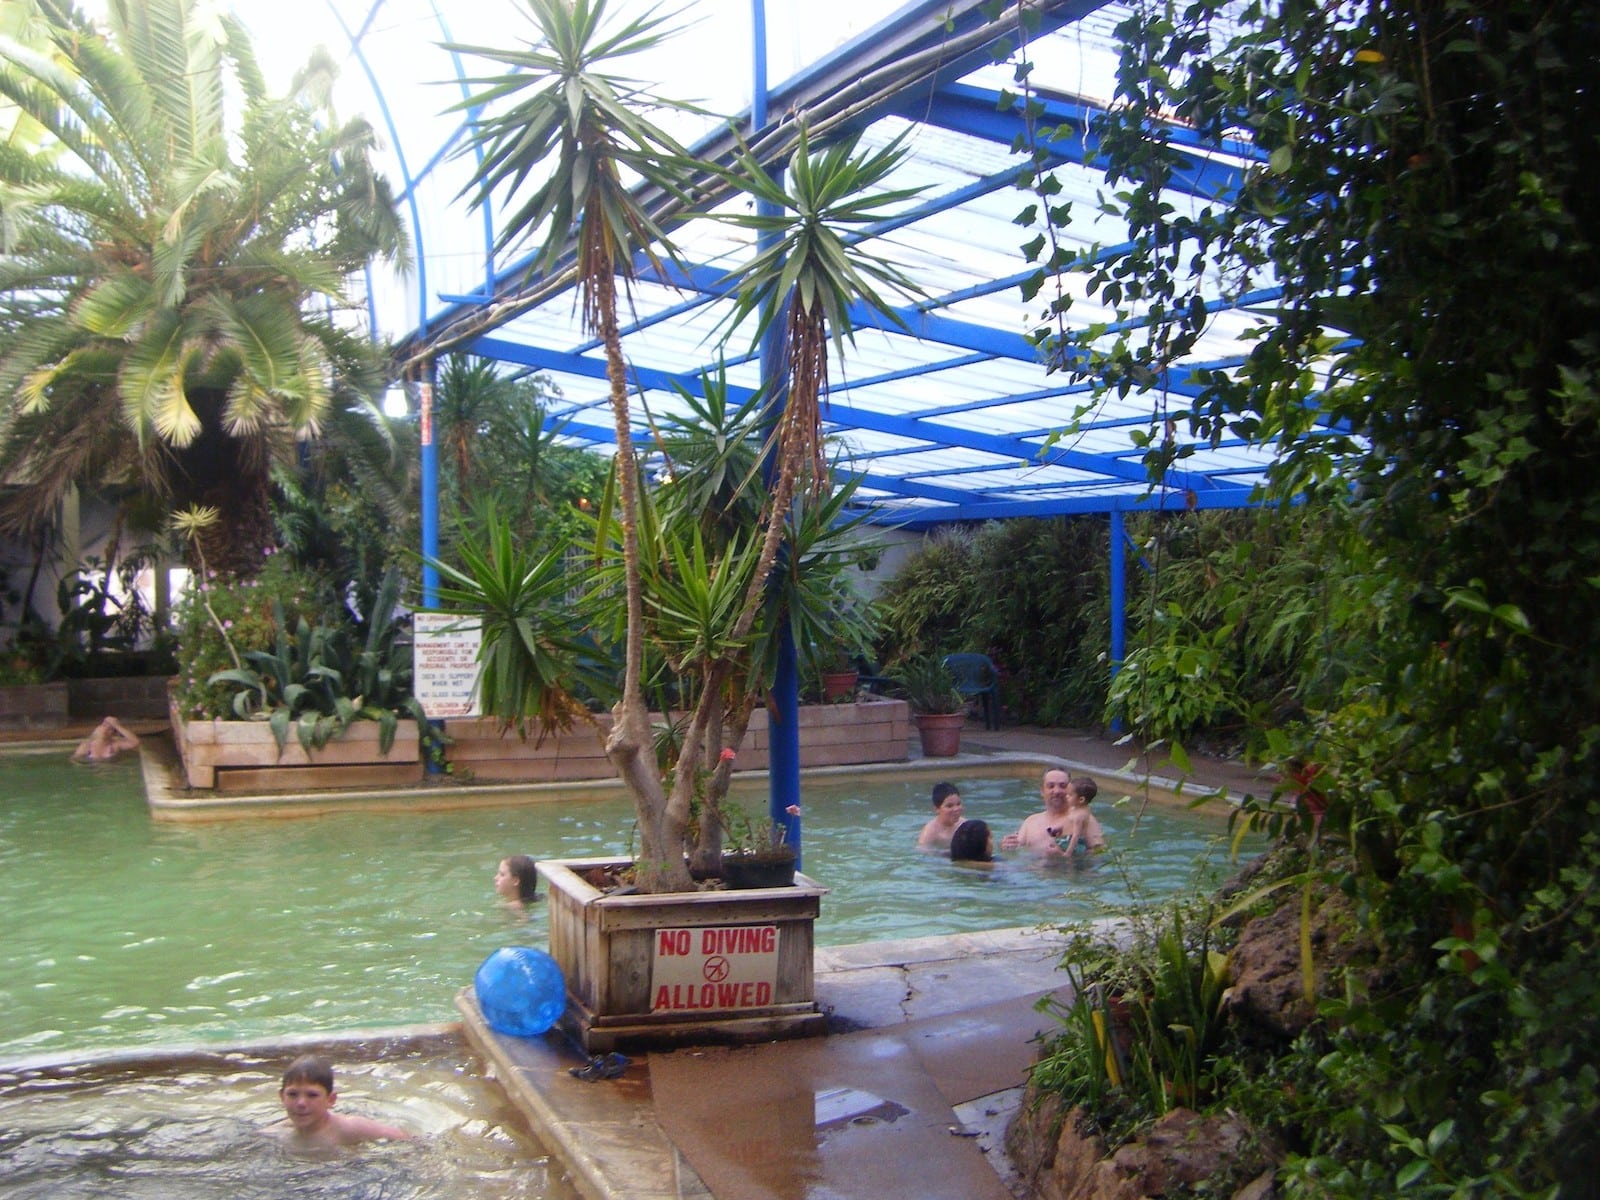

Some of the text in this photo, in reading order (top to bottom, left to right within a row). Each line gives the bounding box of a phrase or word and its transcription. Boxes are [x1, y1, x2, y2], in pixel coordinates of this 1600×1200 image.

[660, 927, 776, 956] NO DIVING
[655, 982, 771, 1009] ALLOWED
